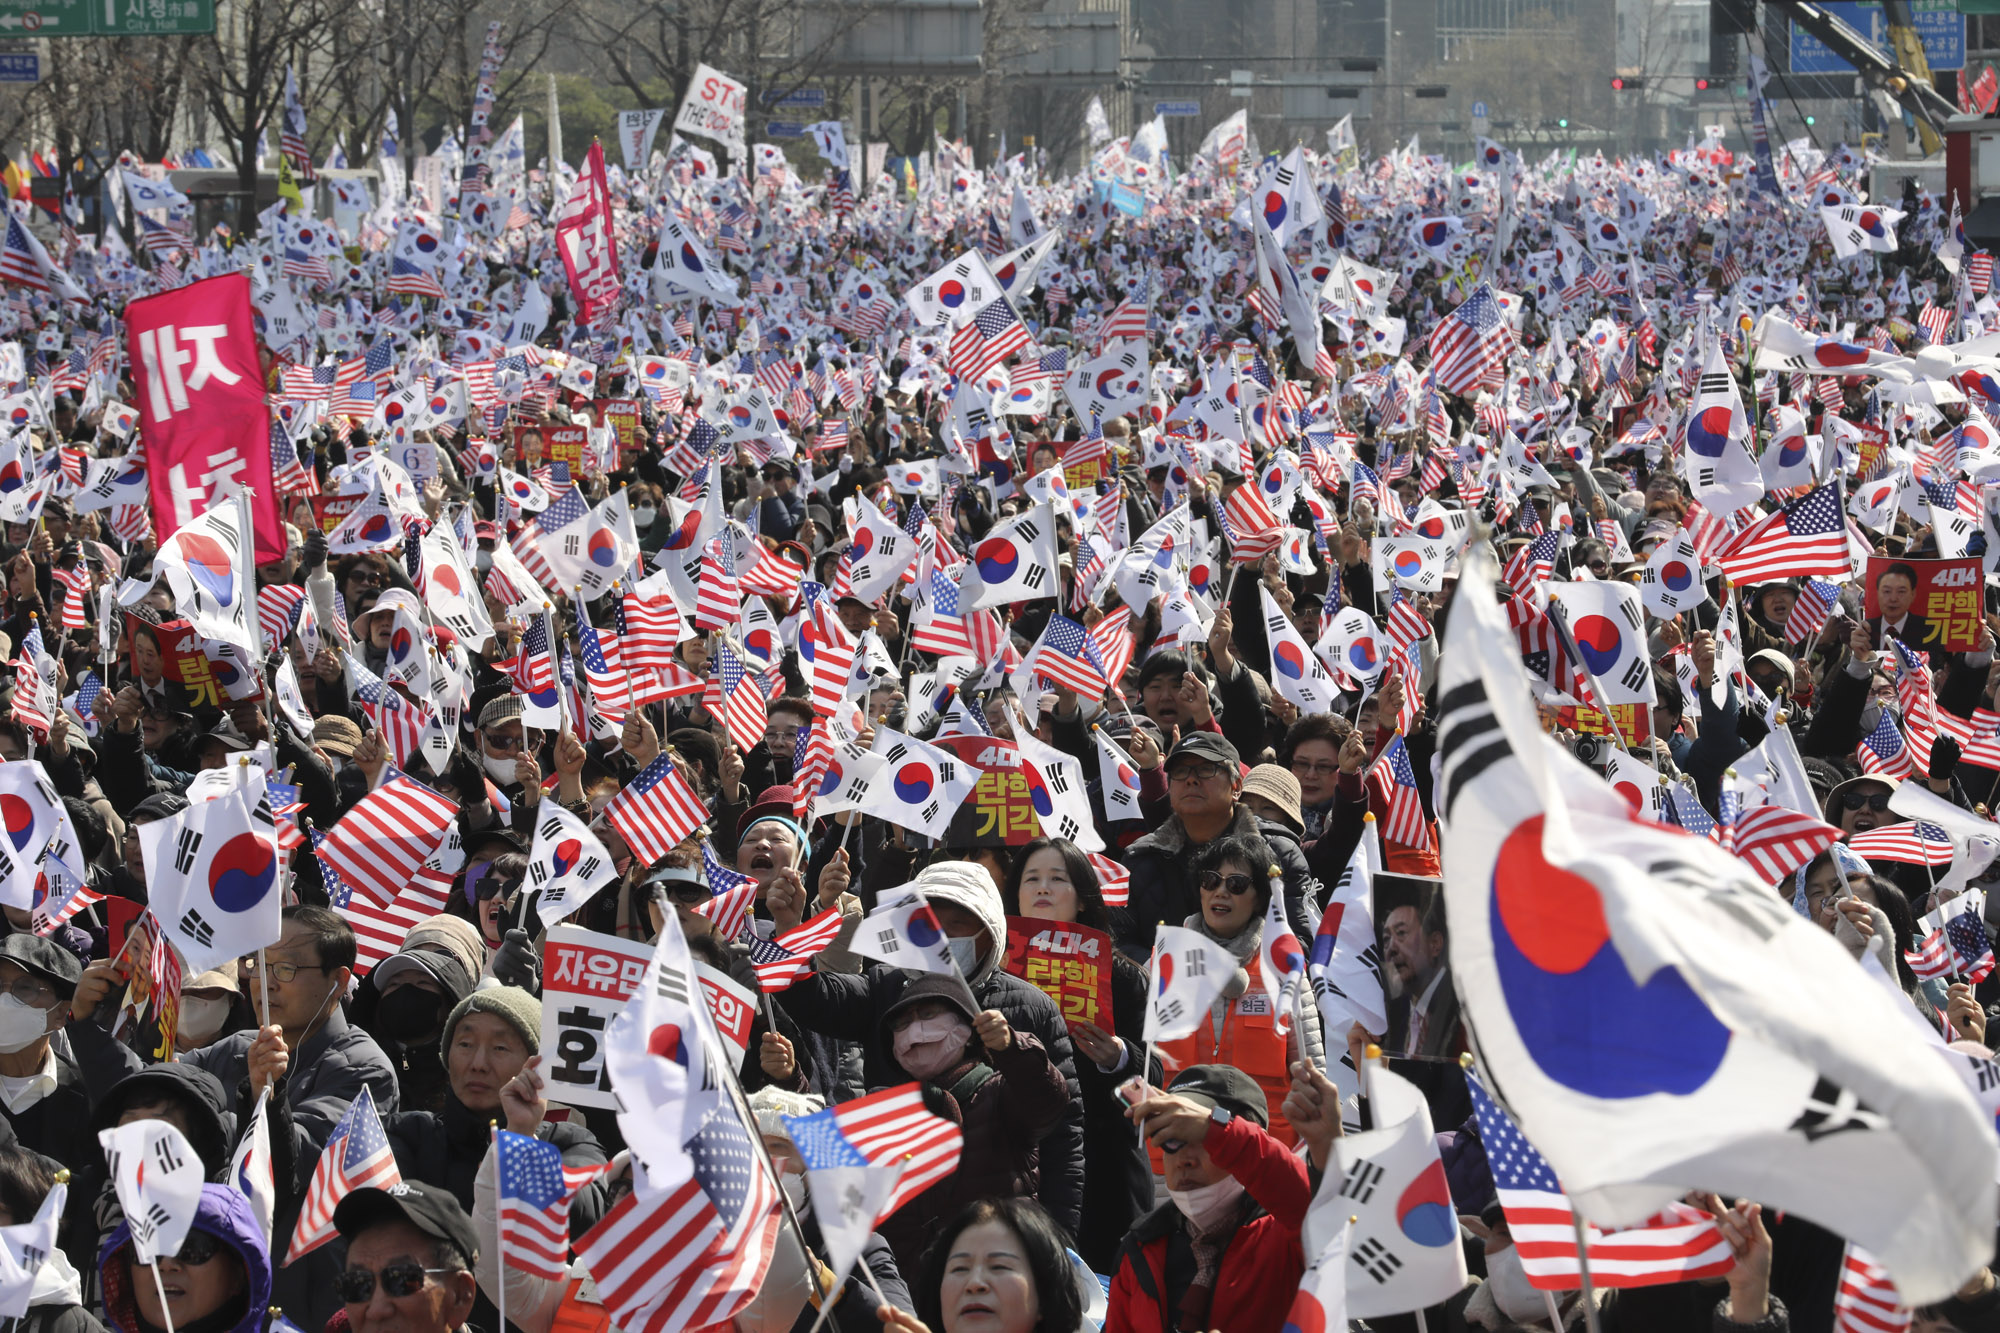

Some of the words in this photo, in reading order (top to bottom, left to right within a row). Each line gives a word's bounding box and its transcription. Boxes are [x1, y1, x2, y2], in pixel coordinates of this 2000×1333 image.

[126, 19, 150, 30] City
[156, 18, 178, 29] Hall
[552, 431, 584, 442] 4대4
[1931, 567, 1977, 587] 4대4
[1927, 590, 1978, 618] 탄핵
[1922, 618, 1978, 645] 기각
[976, 745, 1023, 768] 4대
[976, 805, 1040, 838] 기각
[1029, 929, 1100, 959] 4대4
[1027, 957, 1098, 999] 탄핵
[1241, 1000, 1266, 1013] 헌금
